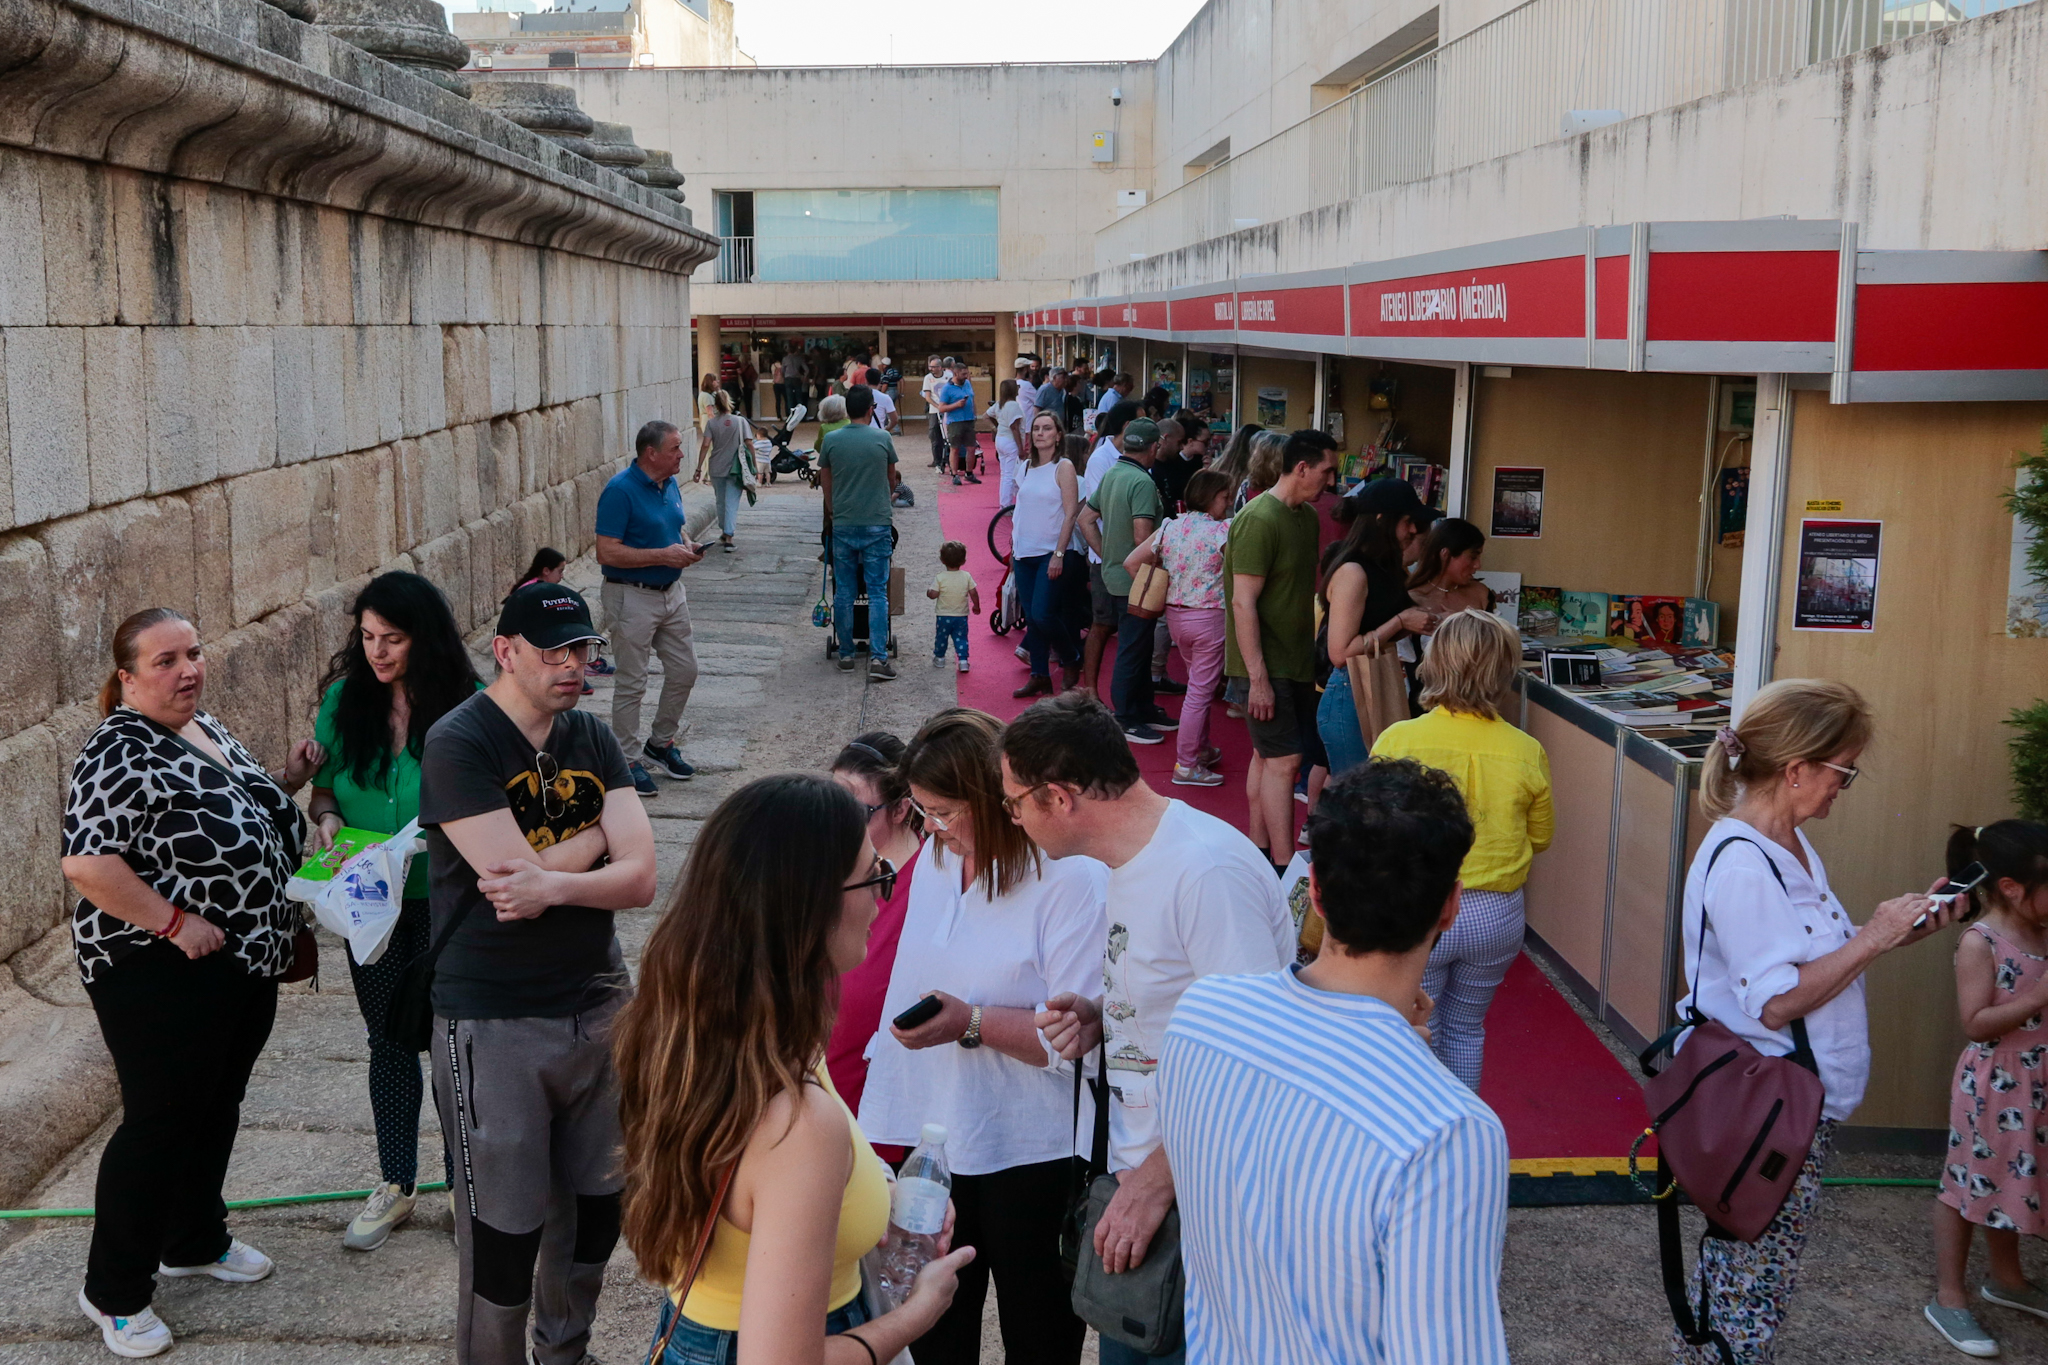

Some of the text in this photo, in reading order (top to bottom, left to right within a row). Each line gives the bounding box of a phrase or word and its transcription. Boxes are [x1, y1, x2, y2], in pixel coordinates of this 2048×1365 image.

[1381, 292, 1408, 322] ATENEO
[1460, 277, 1507, 322] (MÉRIDA)
[449, 1034, 459, 1071] STRENGTH
[459, 1111, 468, 1146] STRENGTH
